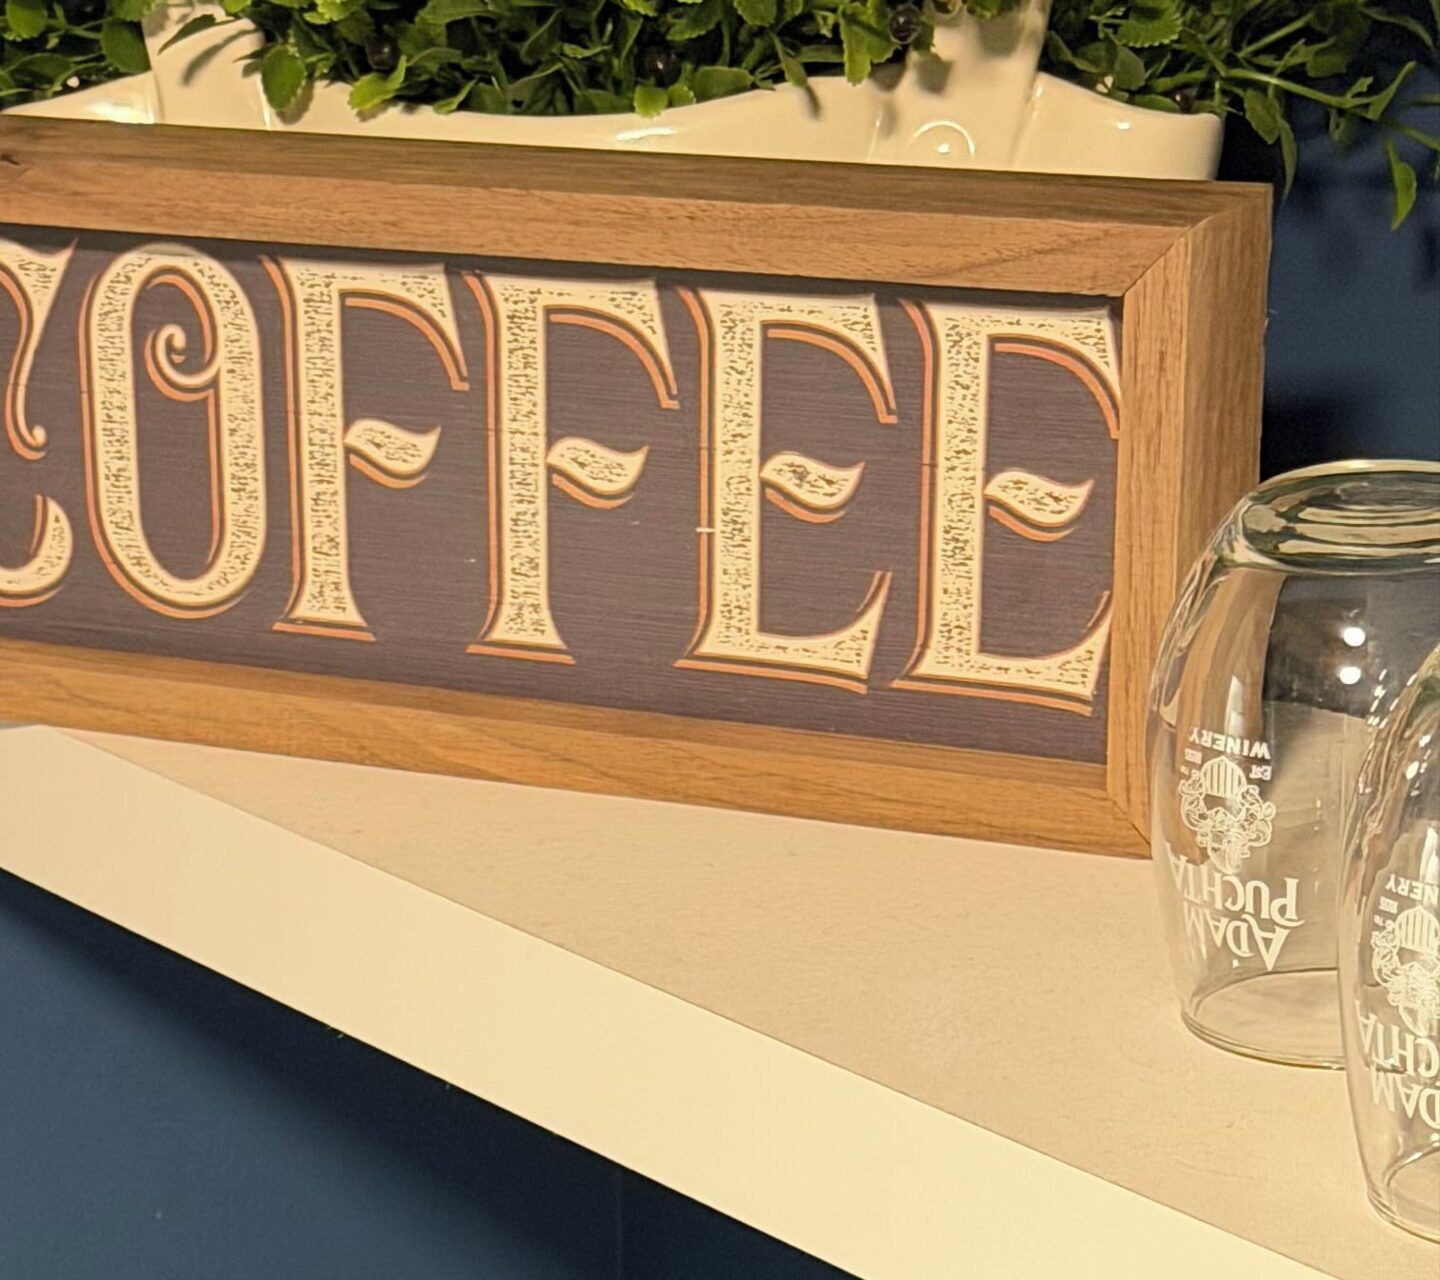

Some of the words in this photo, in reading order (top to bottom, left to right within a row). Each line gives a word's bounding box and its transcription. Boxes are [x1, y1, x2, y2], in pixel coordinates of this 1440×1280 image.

[1188, 727, 1271, 760] WINERY
[1166, 841, 1306, 927] PUCHTA
[1385, 874, 1440, 904] NERY
[1183, 901, 1291, 972] ADAM
